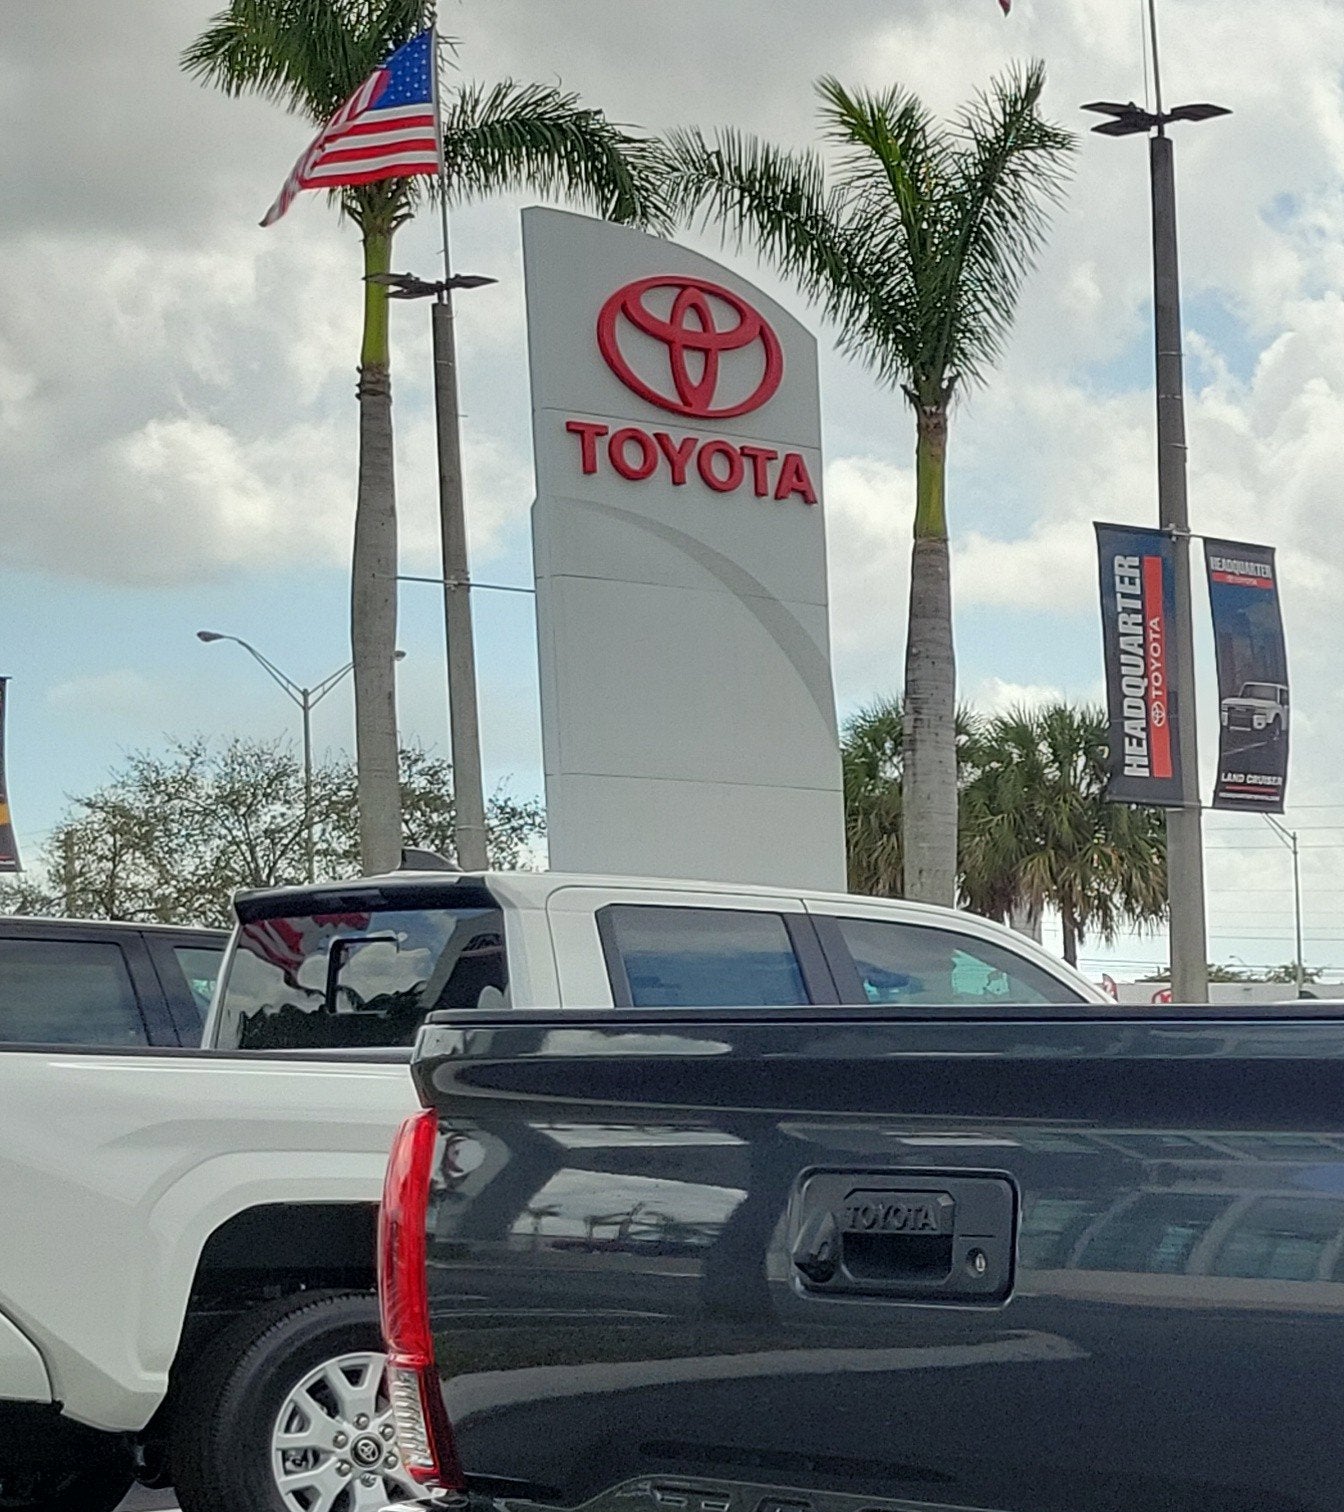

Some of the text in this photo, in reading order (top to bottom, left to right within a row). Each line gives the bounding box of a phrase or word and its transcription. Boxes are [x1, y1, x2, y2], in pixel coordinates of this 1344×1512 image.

[565, 421, 818, 505] TOYOTA
[1114, 555, 1149, 778] HEADQUARTER
[1149, 616, 1164, 699] TOYOTA
[1221, 772, 1283, 786] LAND CRUISER
[846, 1202, 938, 1232] TOYOTA
